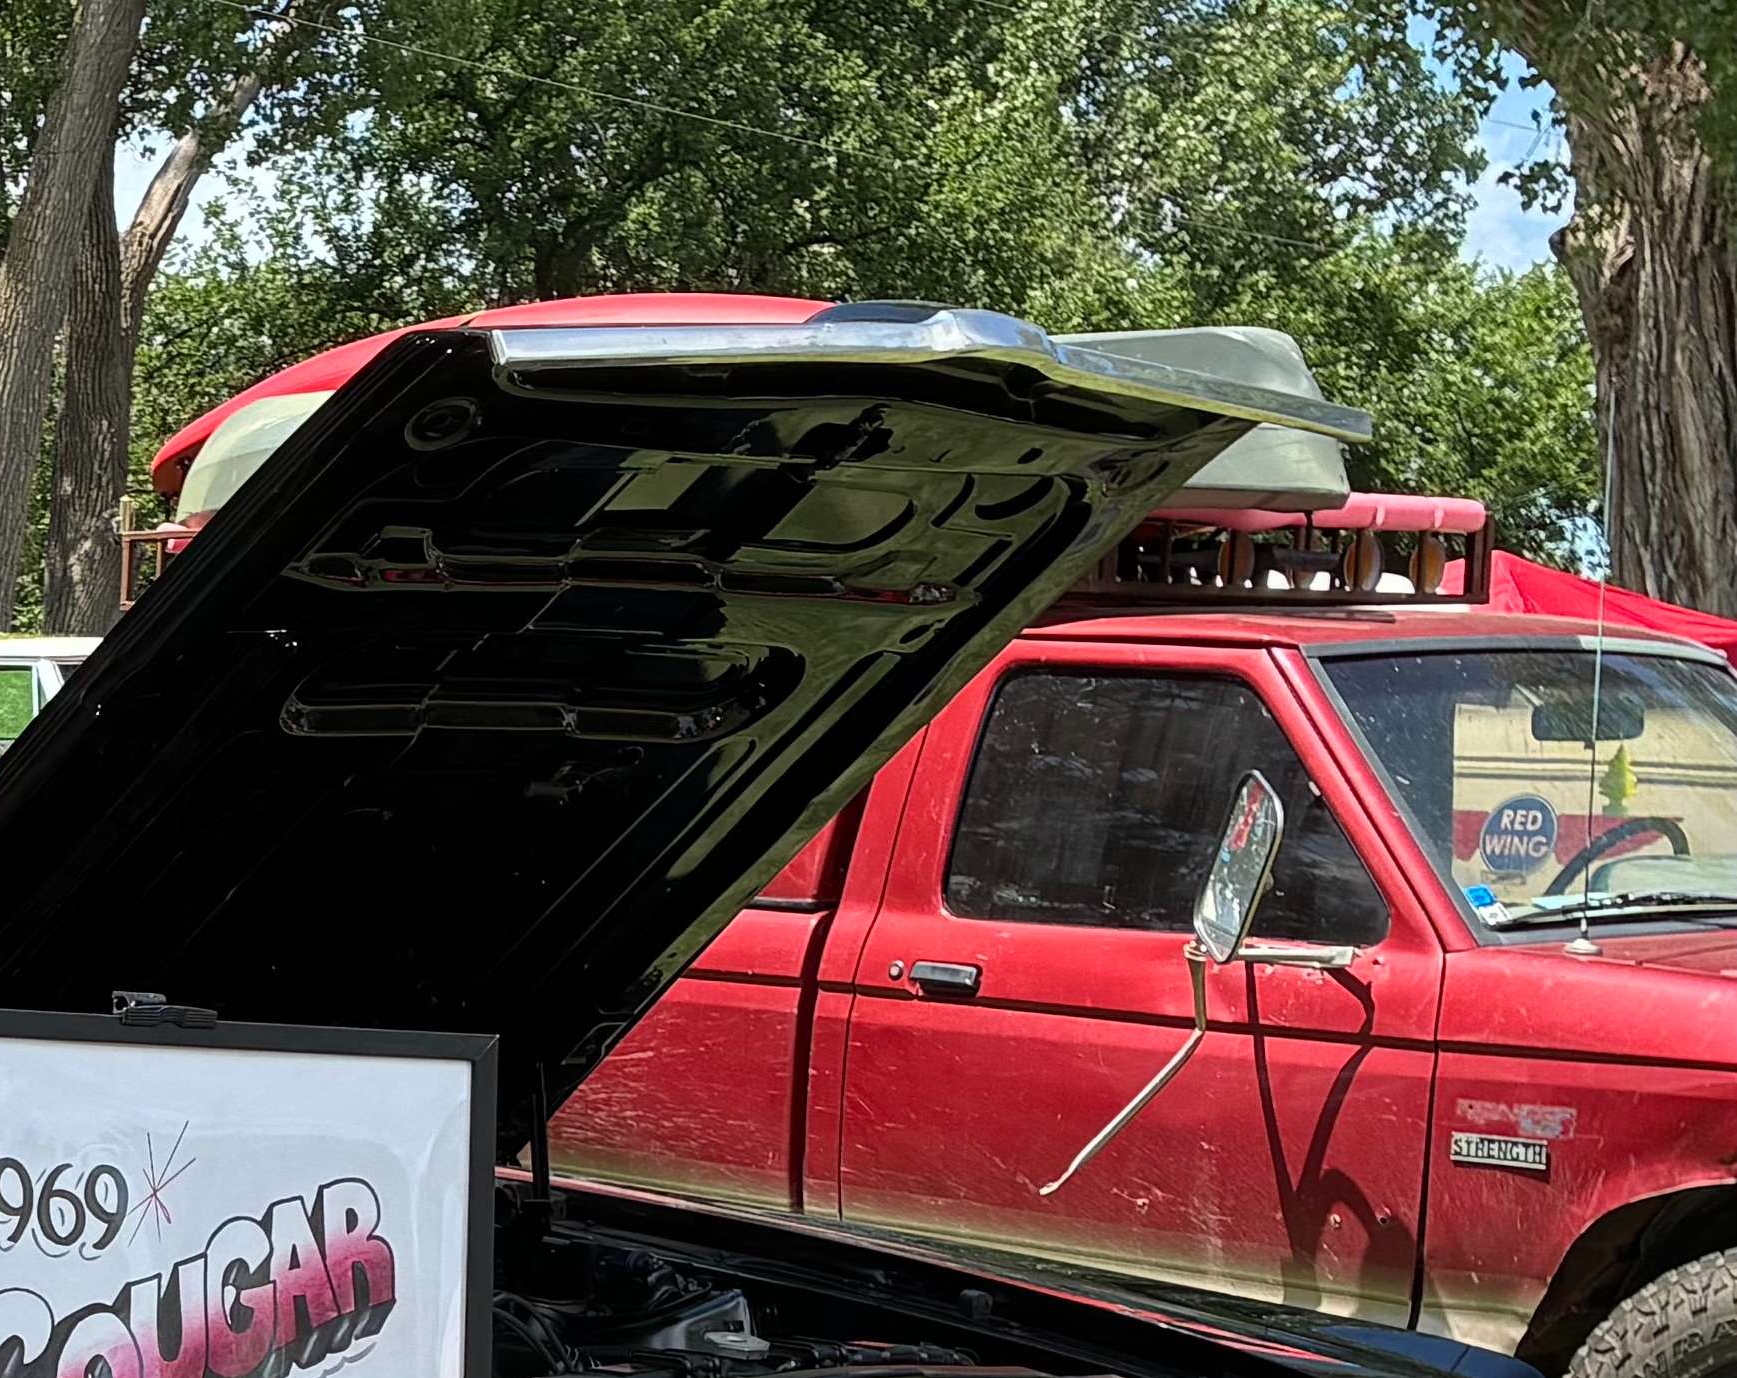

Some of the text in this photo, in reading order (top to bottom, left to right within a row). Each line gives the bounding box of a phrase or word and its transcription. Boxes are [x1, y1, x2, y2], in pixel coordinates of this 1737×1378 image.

[1500, 810, 1543, 831] RED
[1485, 834, 1548, 858] WING
[1452, 1138, 1547, 1165] STRENGTH
